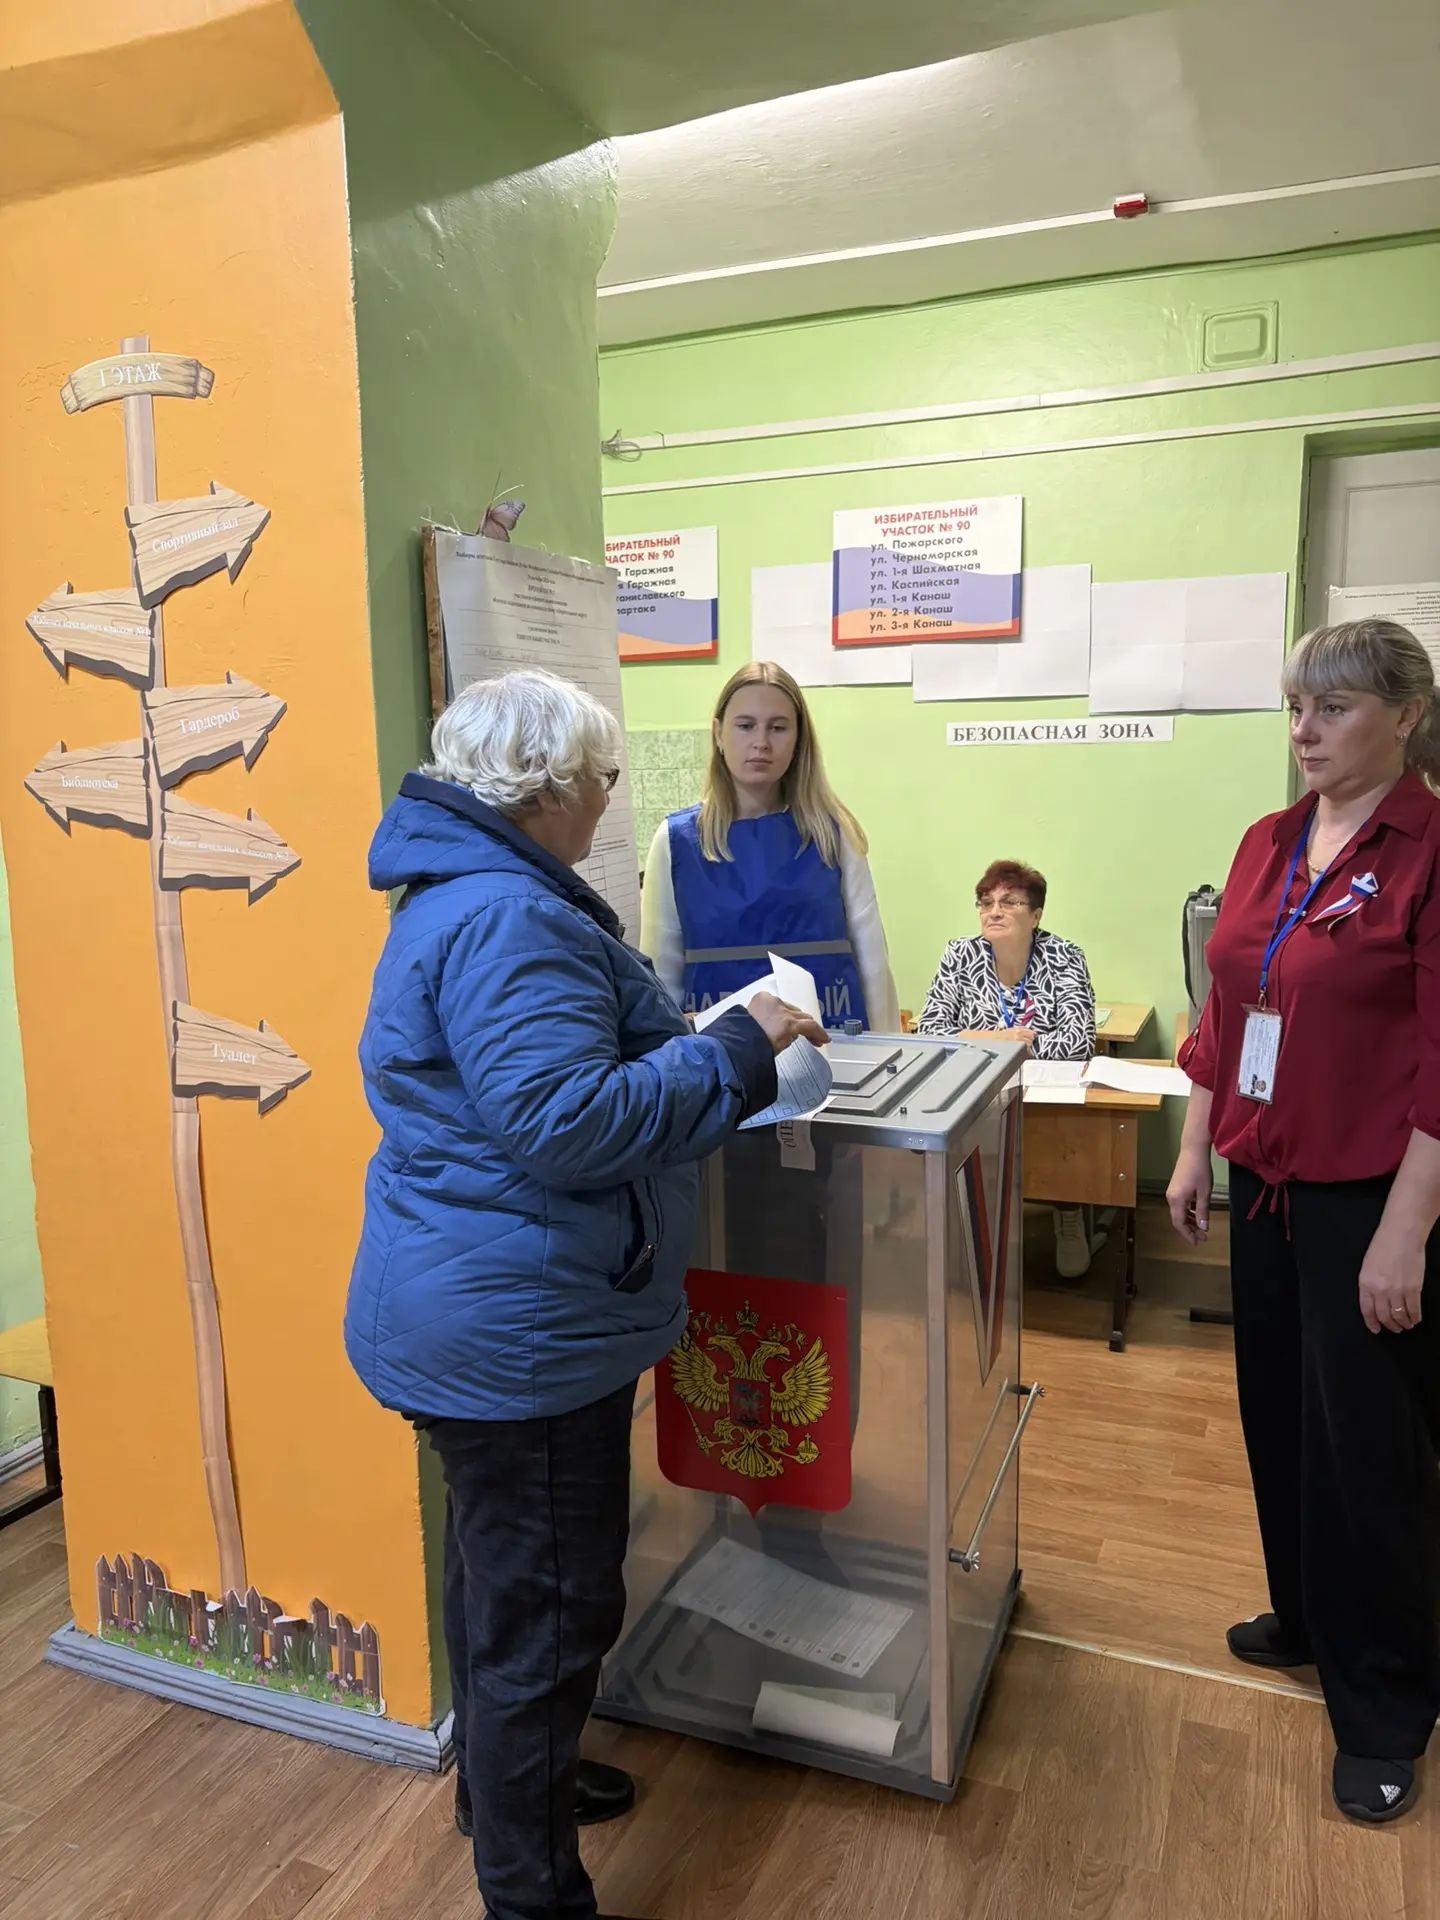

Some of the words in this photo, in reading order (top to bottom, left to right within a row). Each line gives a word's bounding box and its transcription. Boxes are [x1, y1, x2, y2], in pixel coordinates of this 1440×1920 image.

[111, 362, 163, 385] ЭТАЖ
[874, 505, 978, 525] ИЗБИРАТЕЛЬНЫЙ
[881, 524, 935, 537] УЧАСТОК
[939, 523, 952, 533] №
[957, 521, 970, 531] 90
[152, 525, 219, 552] Спортивный
[605, 534, 681, 552] БИРАТЕЛЬНЫЙ
[871, 543, 887, 553] ул.
[892, 536, 963, 550] Пожарского
[605, 553, 645, 564] ЧАСТОК
[648, 551, 660, 561] №
[662, 549, 675, 560] 90
[870, 556, 887, 566] ул.
[892, 549, 978, 563] Черноморская
[625, 565, 674, 578] Гаражная
[870, 570, 887, 580] ул.
[892, 568, 908, 577] 1-я
[912, 562, 981, 575] Шахматная
[627, 578, 677, 591] Гаражная
[870, 583, 887, 593] ул.
[891, 577, 960, 590] Каспийская
[616, 590, 686, 603] аниславского
[870, 597, 886, 606] ул.
[892, 594, 907, 603] 1-я
[911, 592, 952, 602] Канаш
[616, 605, 657, 617] артака
[869, 610, 886, 620] ул.
[891, 607, 909, 617] 2-я
[913, 605, 953, 615] Канаш
[869, 623, 886, 633] ул.
[891, 621, 909, 631] 3-я
[913, 619, 953, 629] Канаш
[179, 705, 240, 735] Гардероб
[953, 724, 1088, 742] БЕЗОПАСНАЯ
[1099, 723, 1155, 739] ЗОНА
[61, 775, 119, 790] Библиотека
[211, 1042, 257, 1065] Туалет
